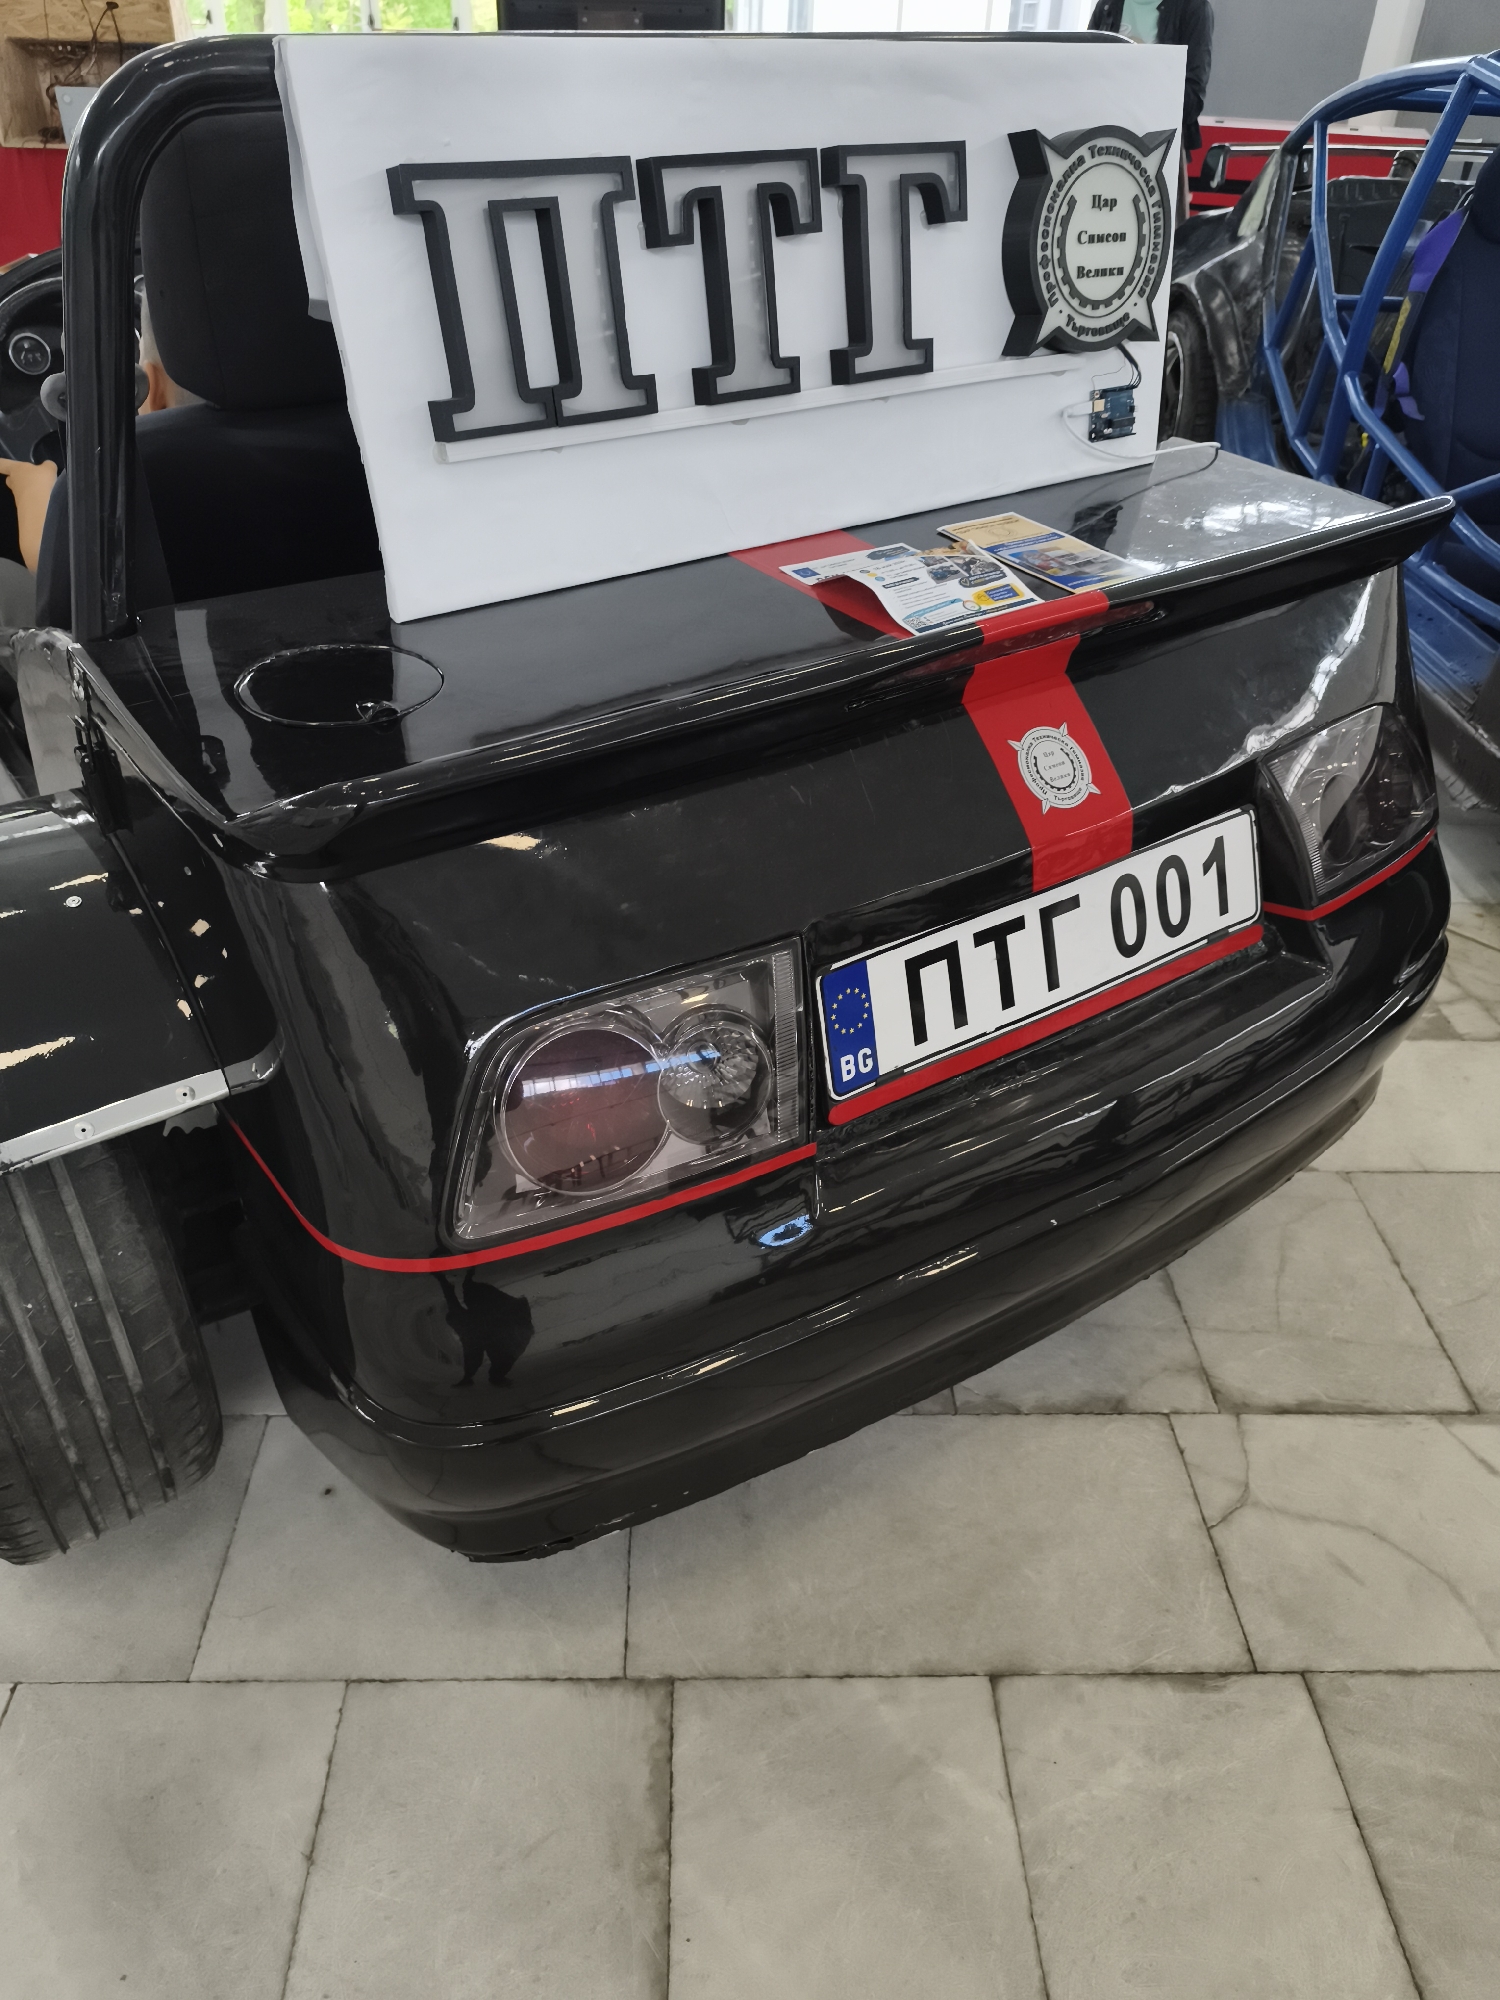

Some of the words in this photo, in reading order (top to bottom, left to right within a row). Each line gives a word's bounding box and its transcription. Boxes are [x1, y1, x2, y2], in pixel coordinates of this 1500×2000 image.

[1091, 194, 1118, 212] Цар
[1039, 154, 1087, 307] Професионална
[1087, 144, 1156, 198] Техническа
[1137, 199, 1162, 299] Гимназия
[1077, 230, 1127, 245] Симеон
[1076, 265, 1125, 279] Велики
[386, 140, 968, 442] ПТГ
[1065, 312, 1131, 338] Търговище
[904, 894, 1081, 1047] ПТГ
[1110, 835, 1230, 959] 001
[841, 1047, 874, 1083] BG
